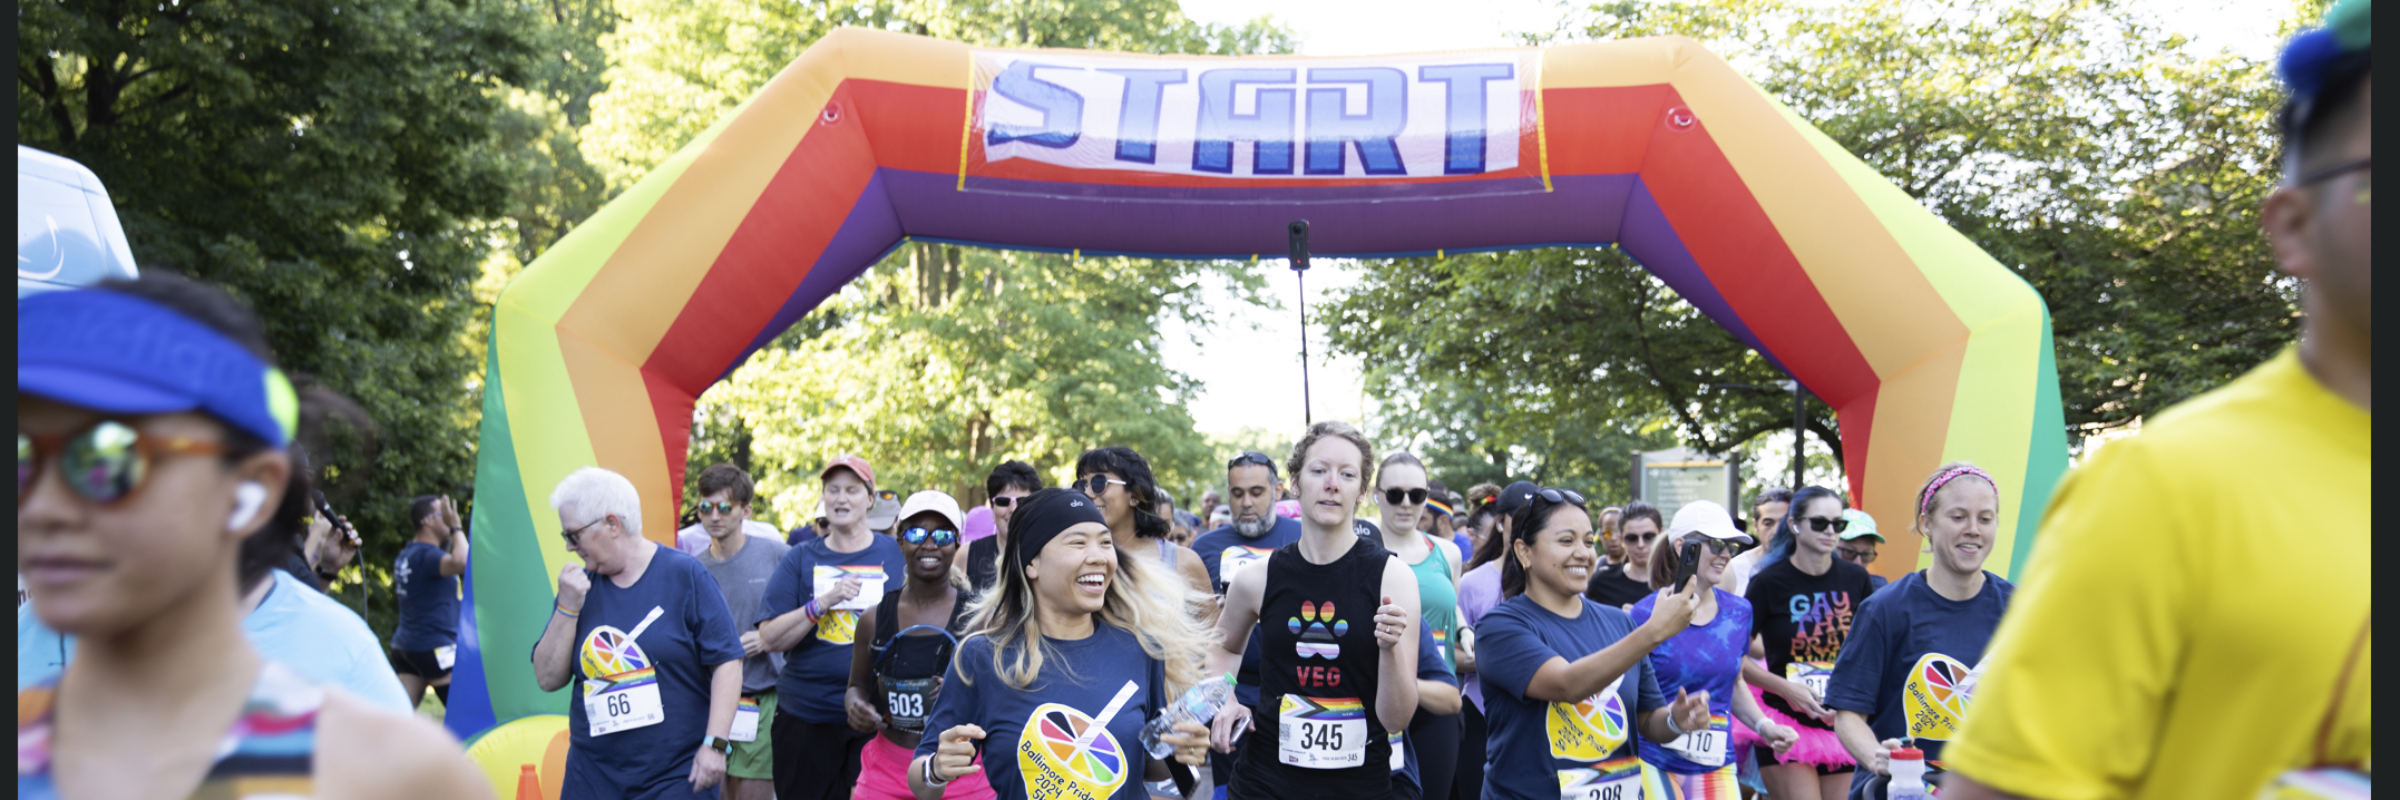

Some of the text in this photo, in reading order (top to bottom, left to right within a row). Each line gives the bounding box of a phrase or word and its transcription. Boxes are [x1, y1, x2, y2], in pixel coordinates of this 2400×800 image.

[987, 59, 1514, 175] START
[1353, 524, 1371, 536] alo
[1789, 591, 1850, 616] GAY
[1791, 611, 1853, 638] THE
[1790, 631, 1847, 656] PRA
[1296, 665, 1341, 687] VEG
[607, 693, 631, 717] 66
[888, 691, 924, 717] 503
[1907, 681, 1940, 720] Baltimore
[1915, 710, 1938, 730] 2024
[1301, 722, 1343, 751] 345
[1586, 733, 1608, 755] Pride
[1021, 740, 1065, 785] Baltimore
[1347, 753, 1358, 762] 345
[1034, 773, 1063, 799] 2024
